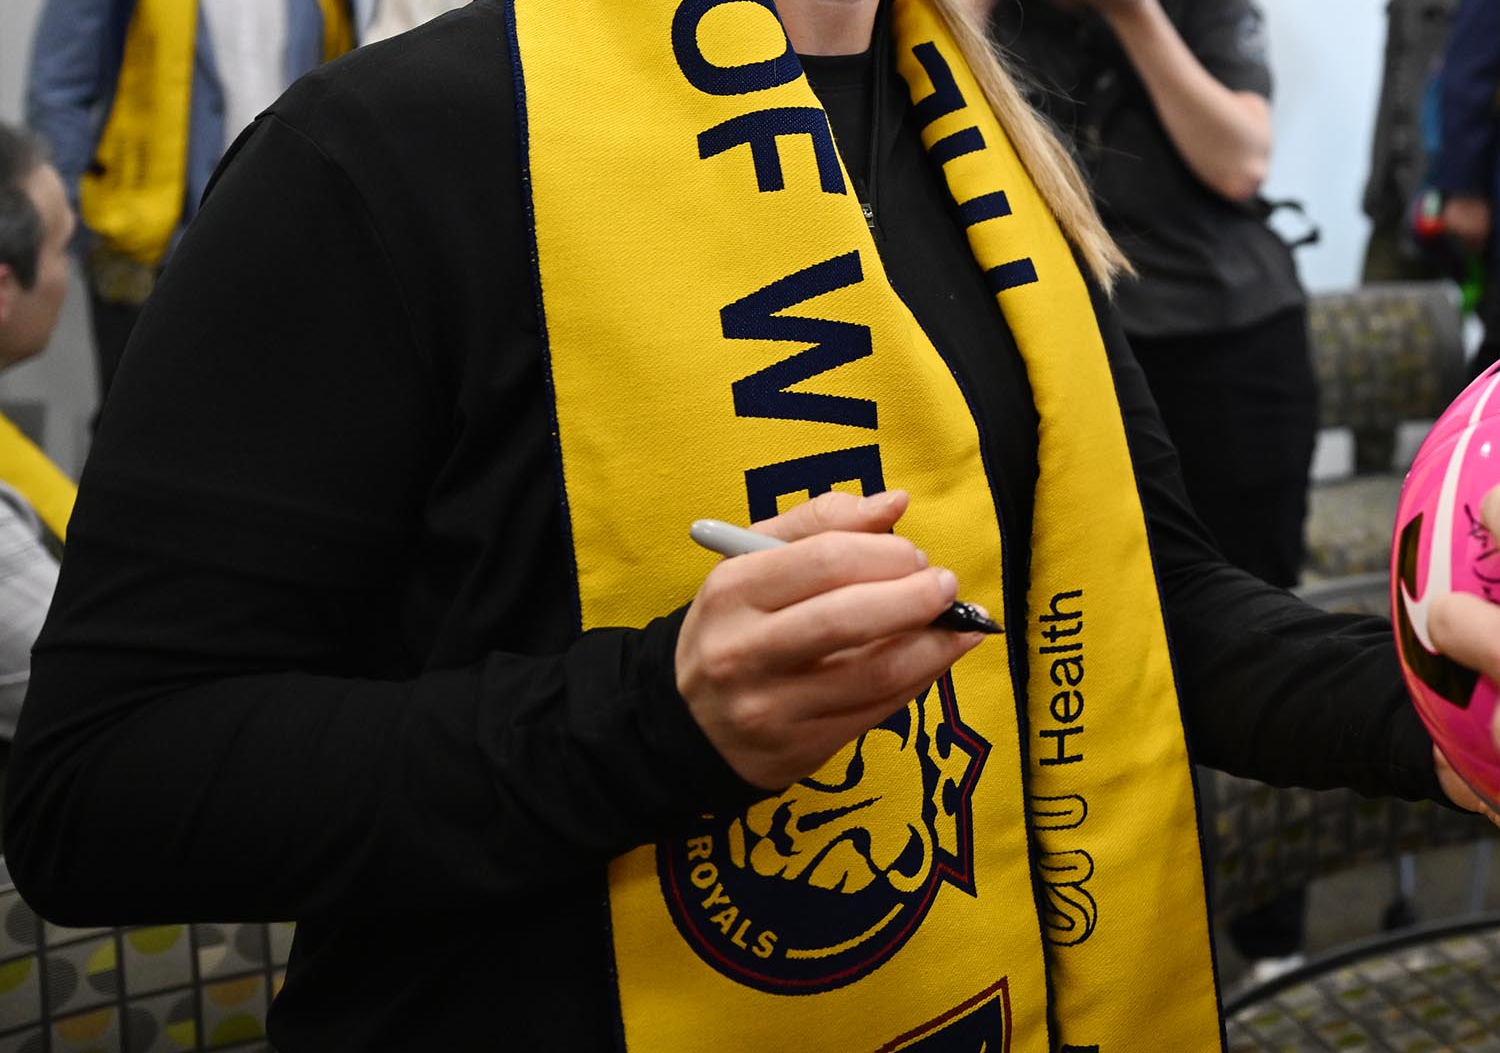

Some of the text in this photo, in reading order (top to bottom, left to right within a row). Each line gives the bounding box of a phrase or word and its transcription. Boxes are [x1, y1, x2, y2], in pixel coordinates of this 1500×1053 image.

[719, 249, 895, 534] WE
[1039, 589, 1085, 767] Health
[687, 834, 780, 959] ROYALS
